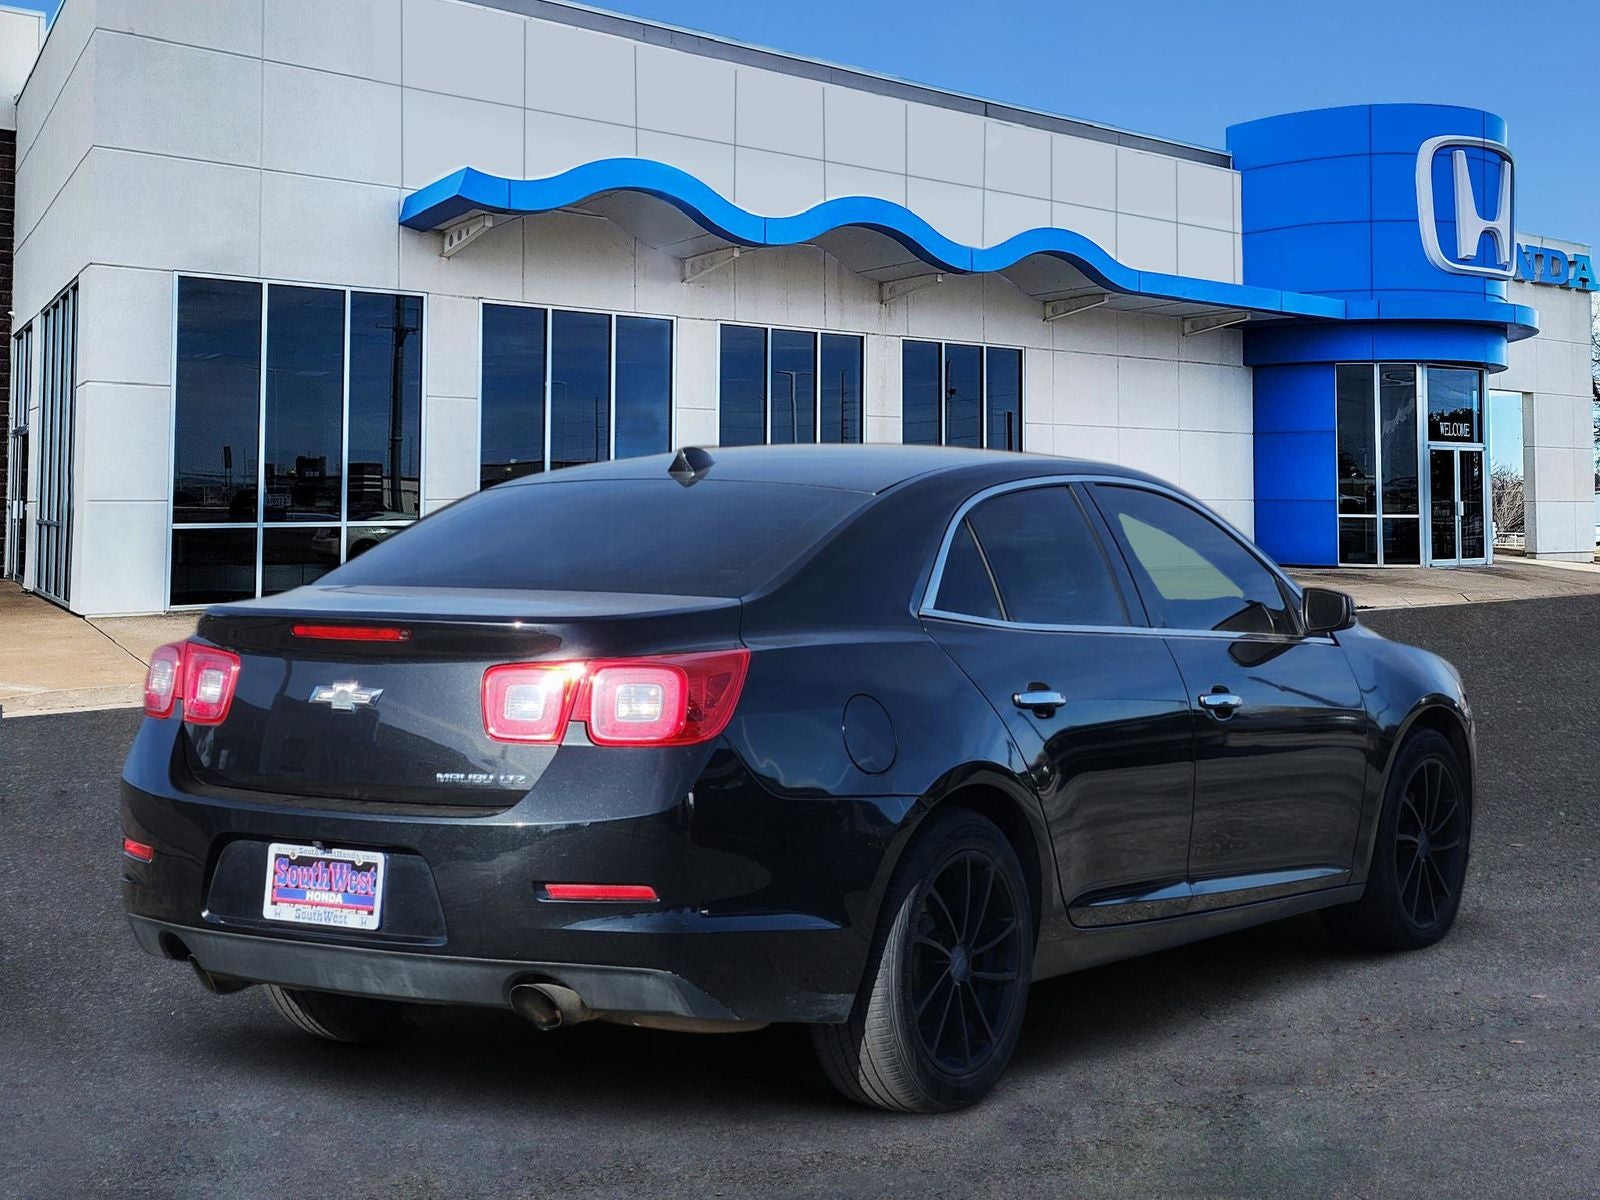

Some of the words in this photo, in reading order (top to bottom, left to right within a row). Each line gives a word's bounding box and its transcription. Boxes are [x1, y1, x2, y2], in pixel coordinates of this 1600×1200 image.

[1439, 421, 1471, 437] WELCOME
[436, 772, 494, 784] MALIBU
[499, 774, 526, 784] LTZ
[273, 856, 377, 896] SouthWest
[305, 891, 344, 905] HONDA
[295, 908, 348, 925] SouthWest
